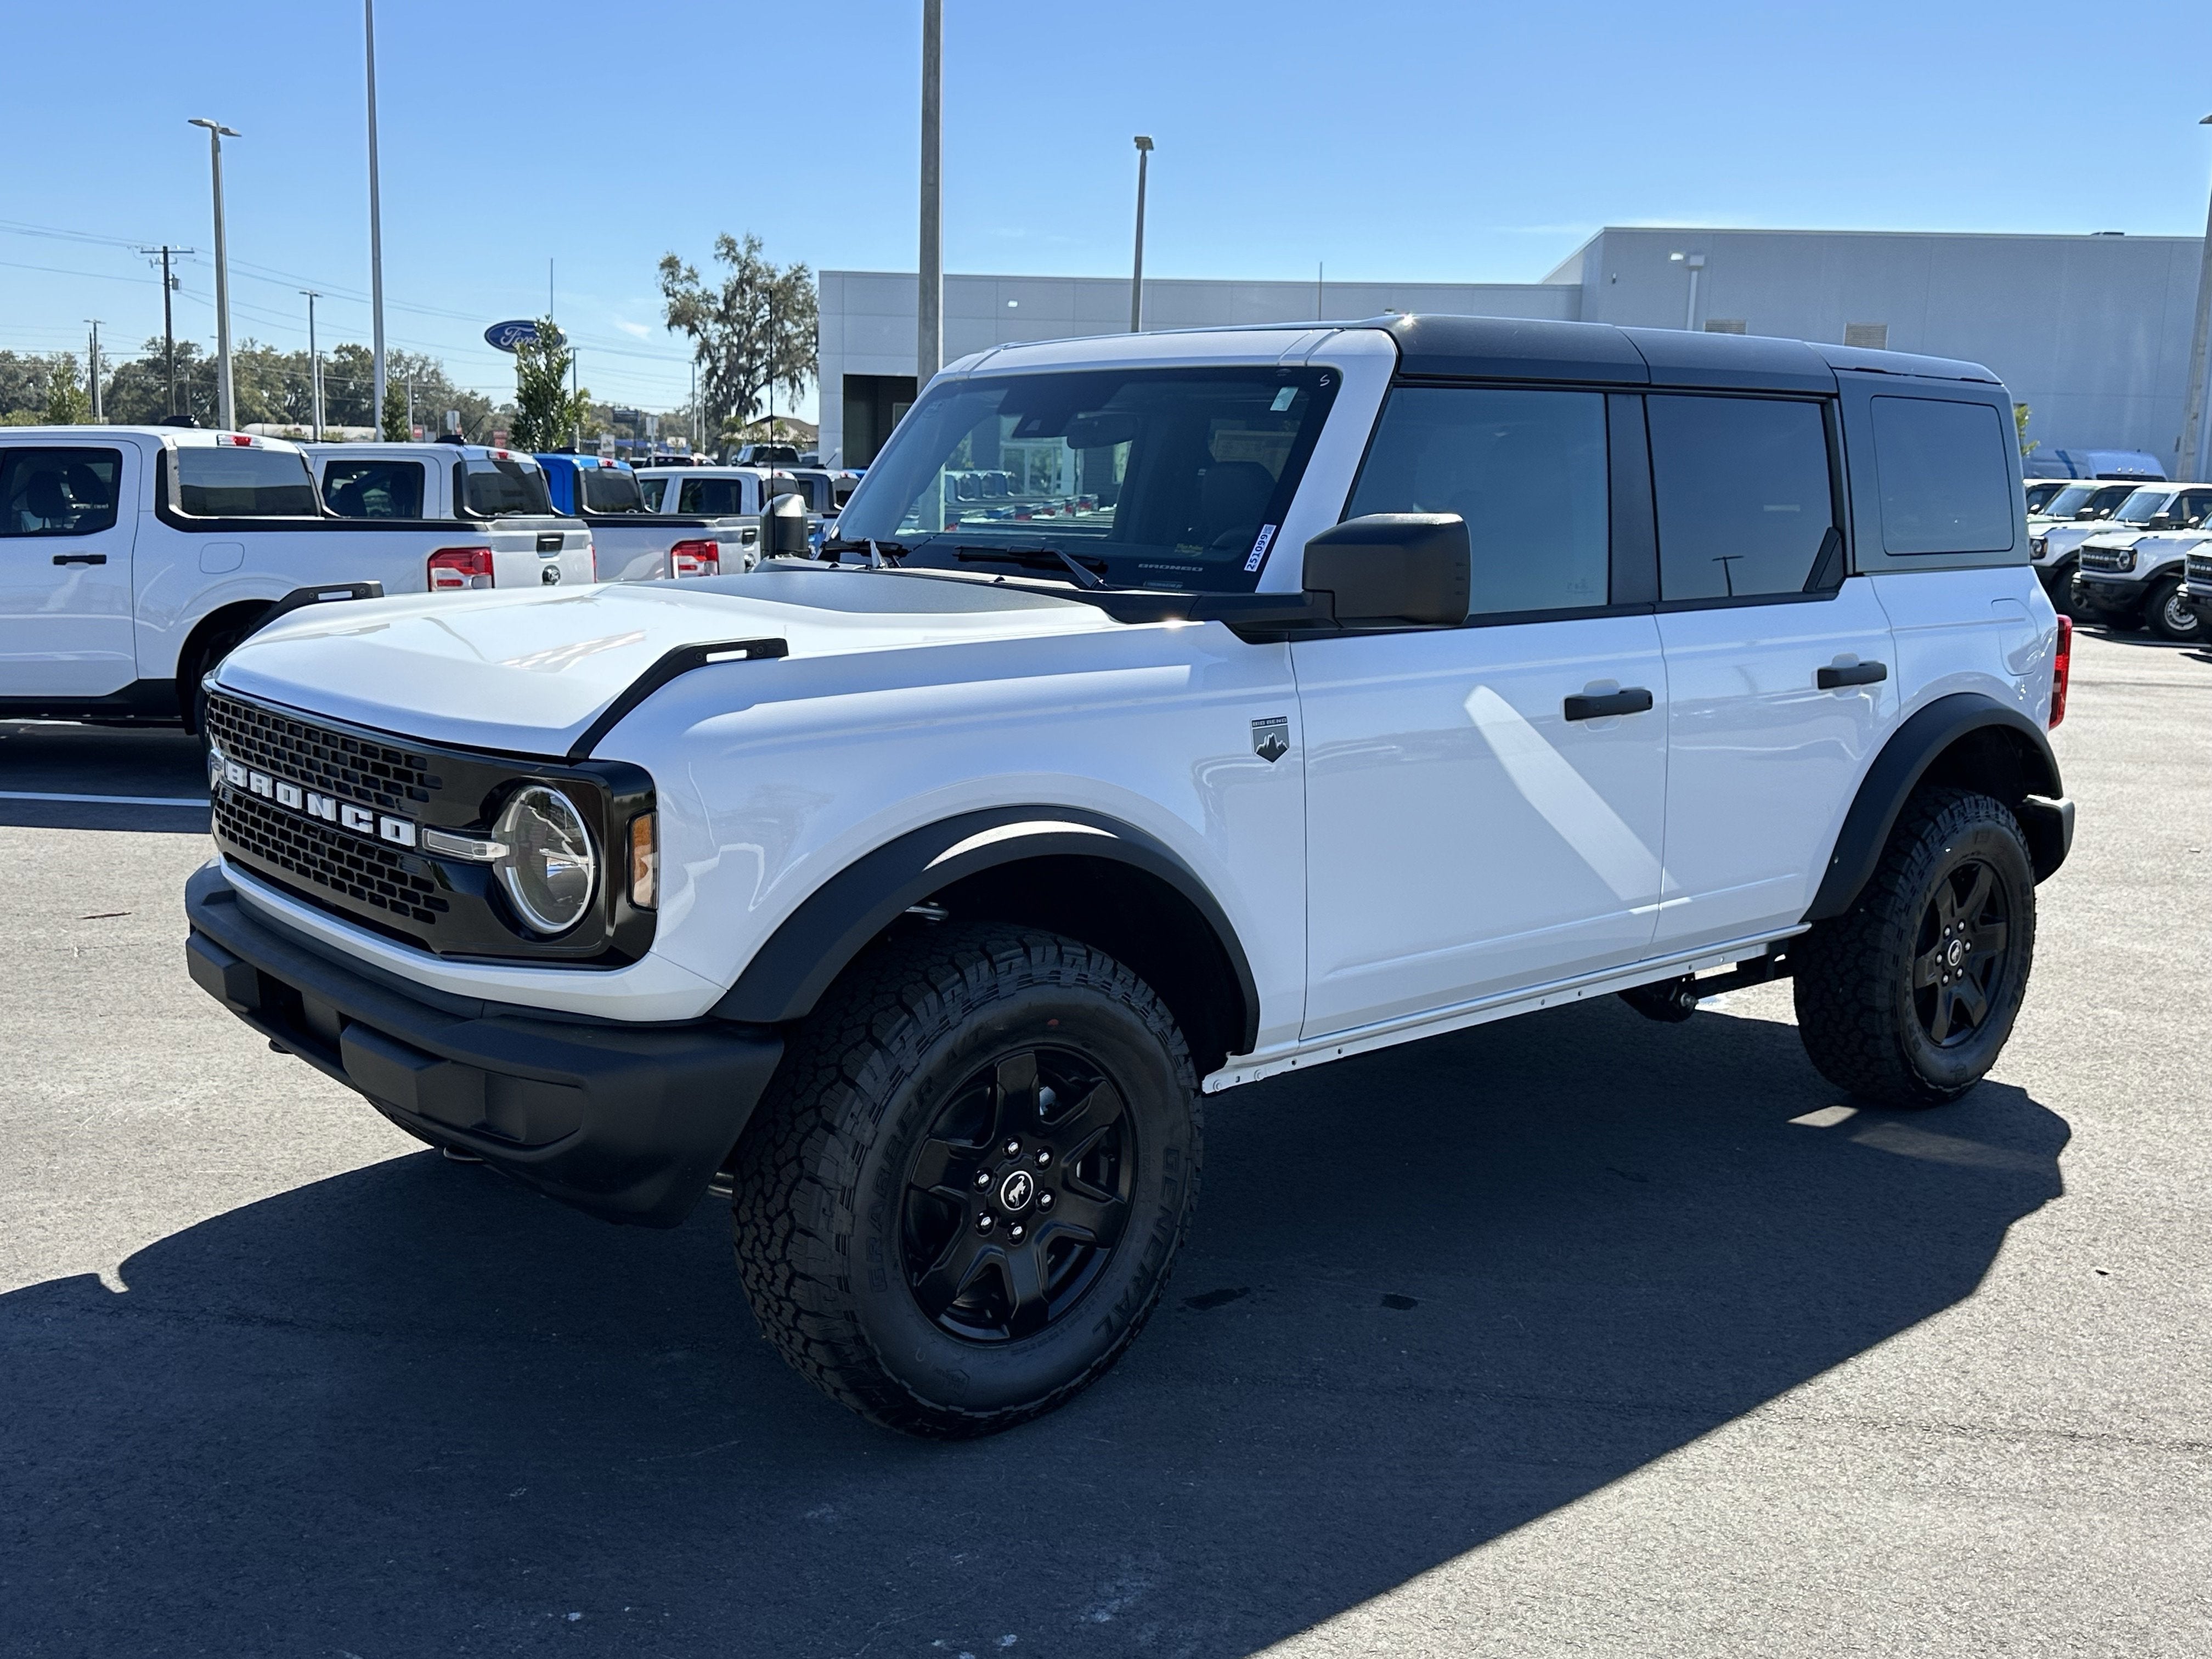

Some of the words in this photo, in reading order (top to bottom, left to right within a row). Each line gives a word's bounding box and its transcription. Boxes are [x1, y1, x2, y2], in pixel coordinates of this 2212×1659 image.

[1247, 534, 1268, 569] 251099
[227, 760, 416, 847] BRONCO
[865, 1075, 934, 1293] GRABBER
[1092, 1146, 1180, 1334] GENERAL
